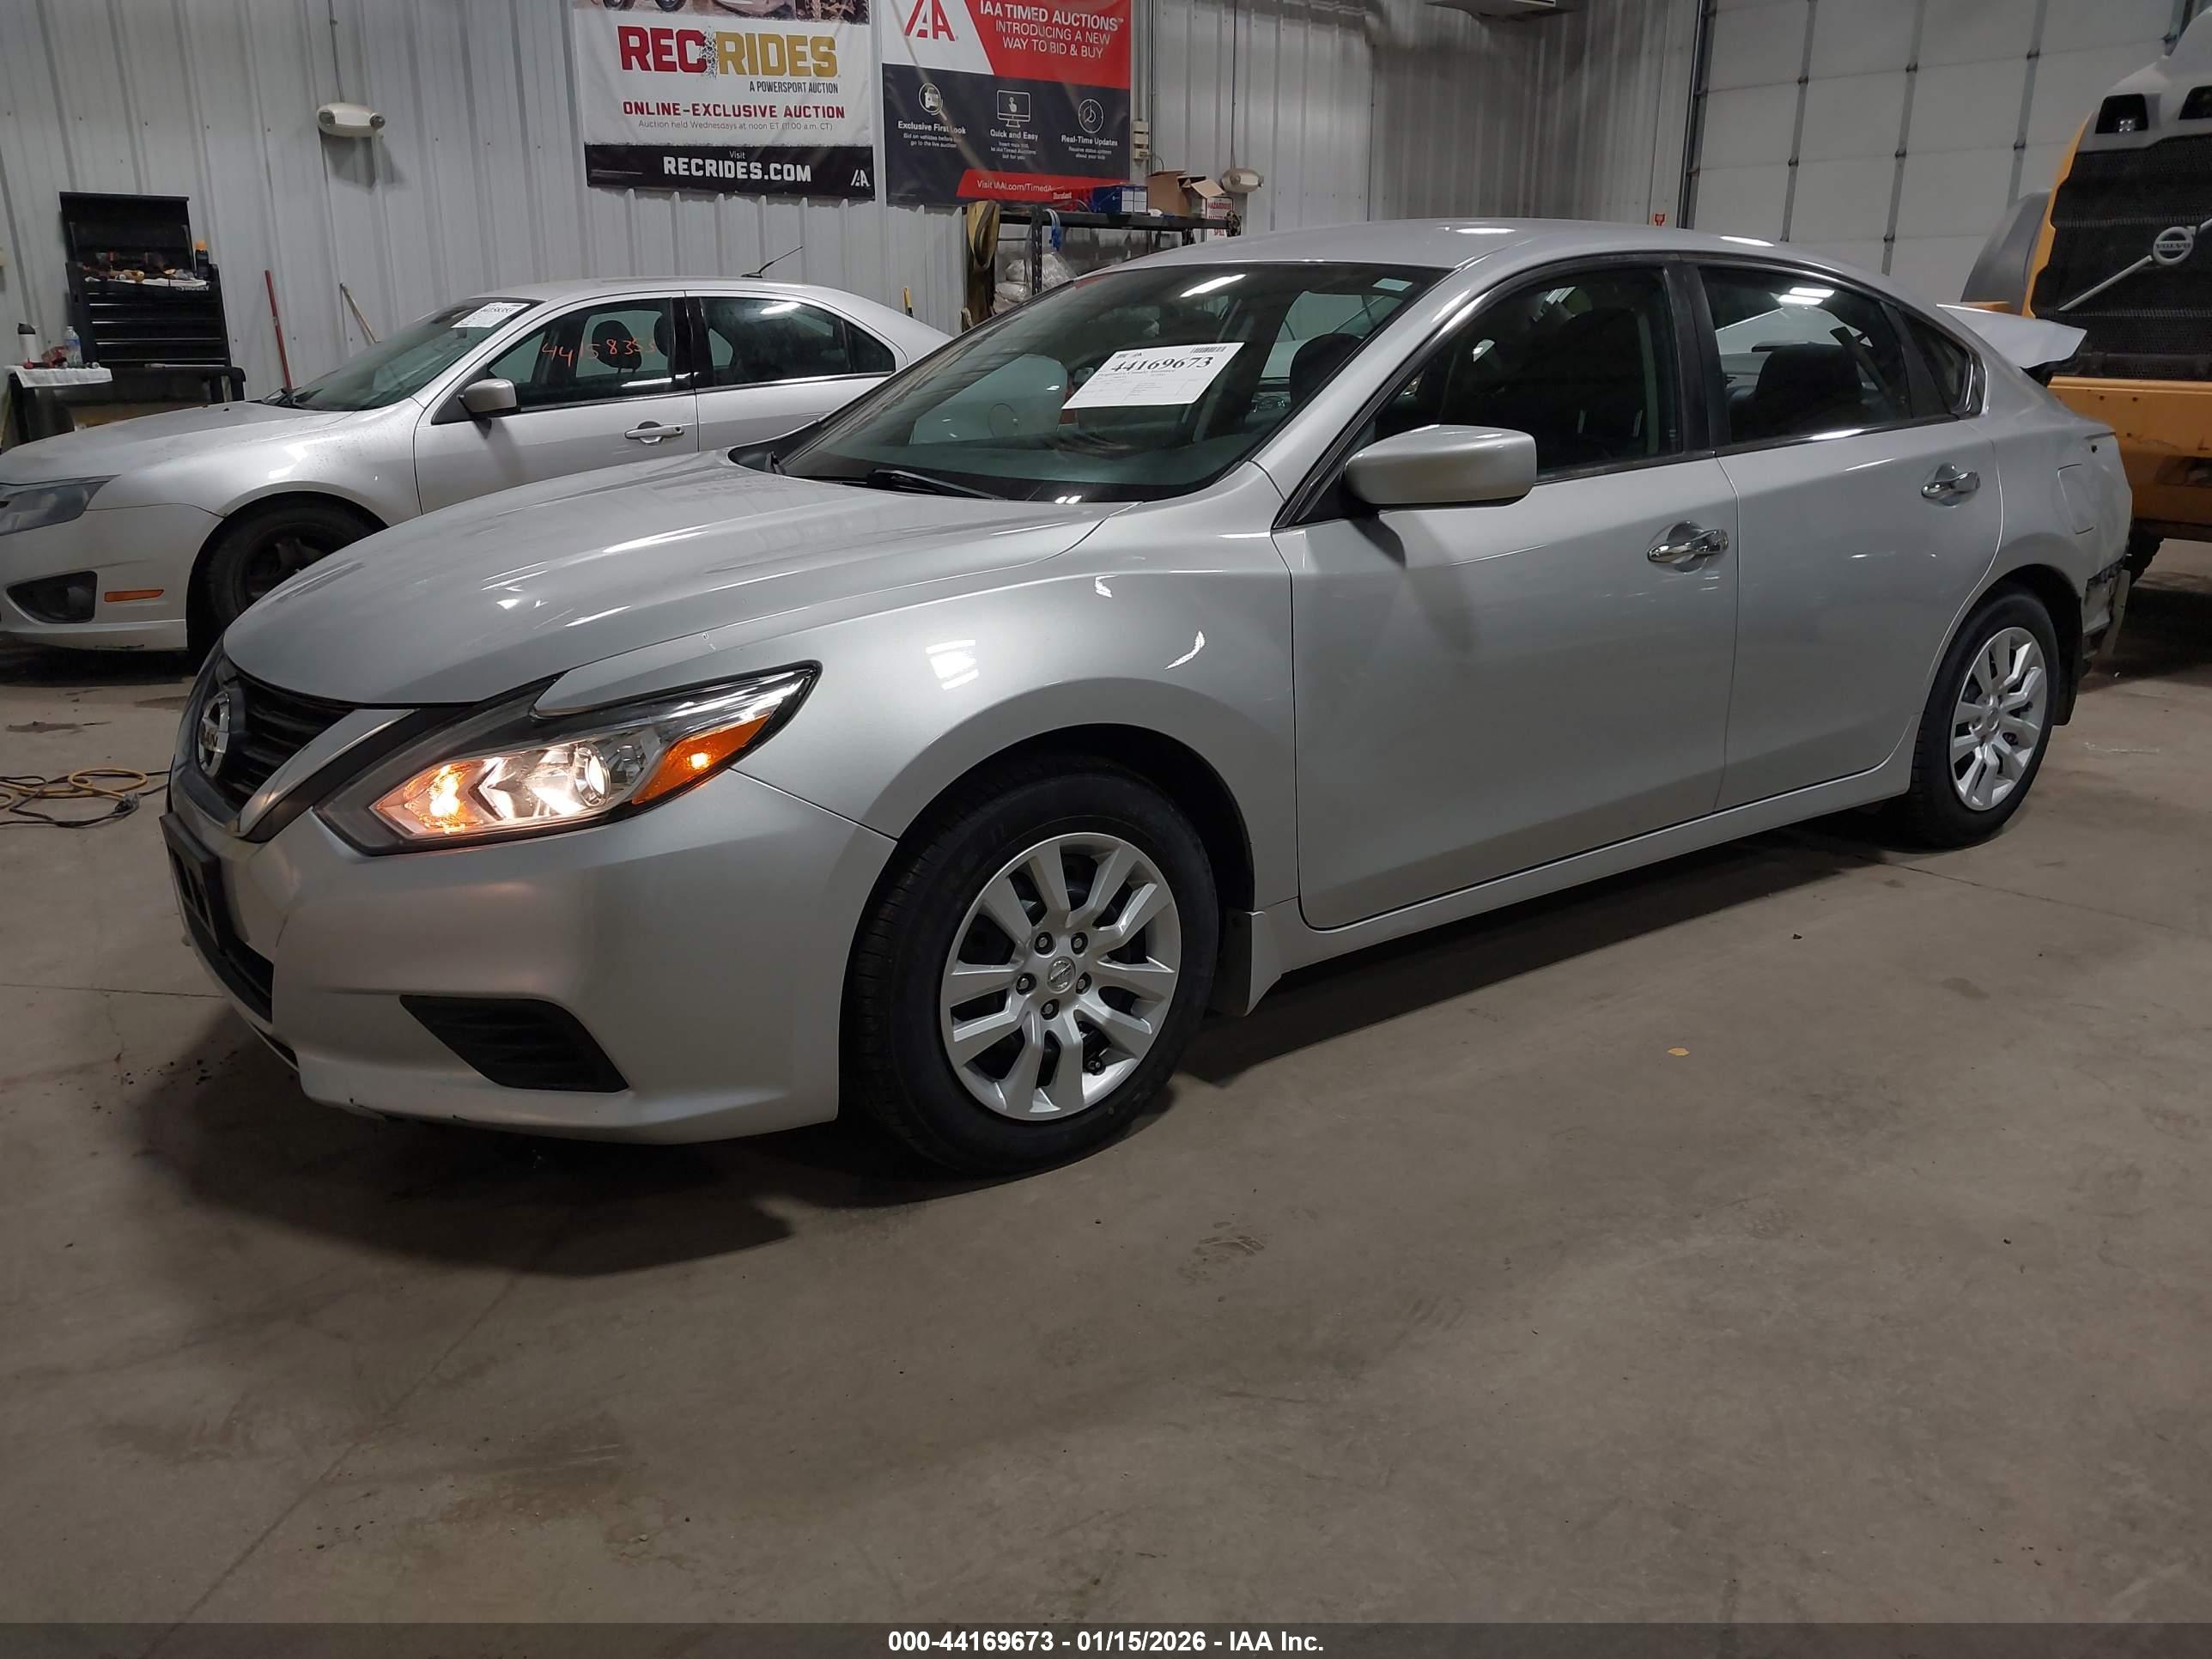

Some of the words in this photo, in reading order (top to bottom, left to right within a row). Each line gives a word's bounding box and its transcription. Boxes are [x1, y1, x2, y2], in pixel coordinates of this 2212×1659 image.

[980, 0, 1002, 17] IAA
[1005, 4, 1048, 22] TIMED
[995, 20, 1072, 40] INTRODUCING
[1074, 30, 1083, 41] A
[1085, 32, 1111, 45] NEW
[1002, 36, 1029, 51] WAY
[1031, 40, 1048, 52] TO
[1050, 43, 1067, 55] BID
[1070, 46, 1078, 56] &
[1080, 46, 1103, 58] BUY
[715, 32, 839, 77] RIDES
[749, 81, 755, 92] A
[757, 81, 807, 94] POWERSPORT
[808, 82, 839, 94] AUCTION
[623, 101, 778, 118] ONLINE-EXCLUSIVE
[783, 105, 846, 118] AUCTION
[690, 120, 738, 130] Wednesdays
[819, 122, 834, 131] CT)
[897, 120, 933, 131] Exclusive
[933, 123, 949, 132] First
[990, 129, 1007, 138] Quick
[1023, 132, 1038, 142] Easy
[1061, 135, 1093, 145] Real-Time
[1094, 137, 1118, 147] Updates
[730, 150, 745, 160] Visit
[663, 156, 811, 183] RECRIDES.COM
[977, 179, 993, 189] Visit
[1110, 356, 1214, 372] 44169673
